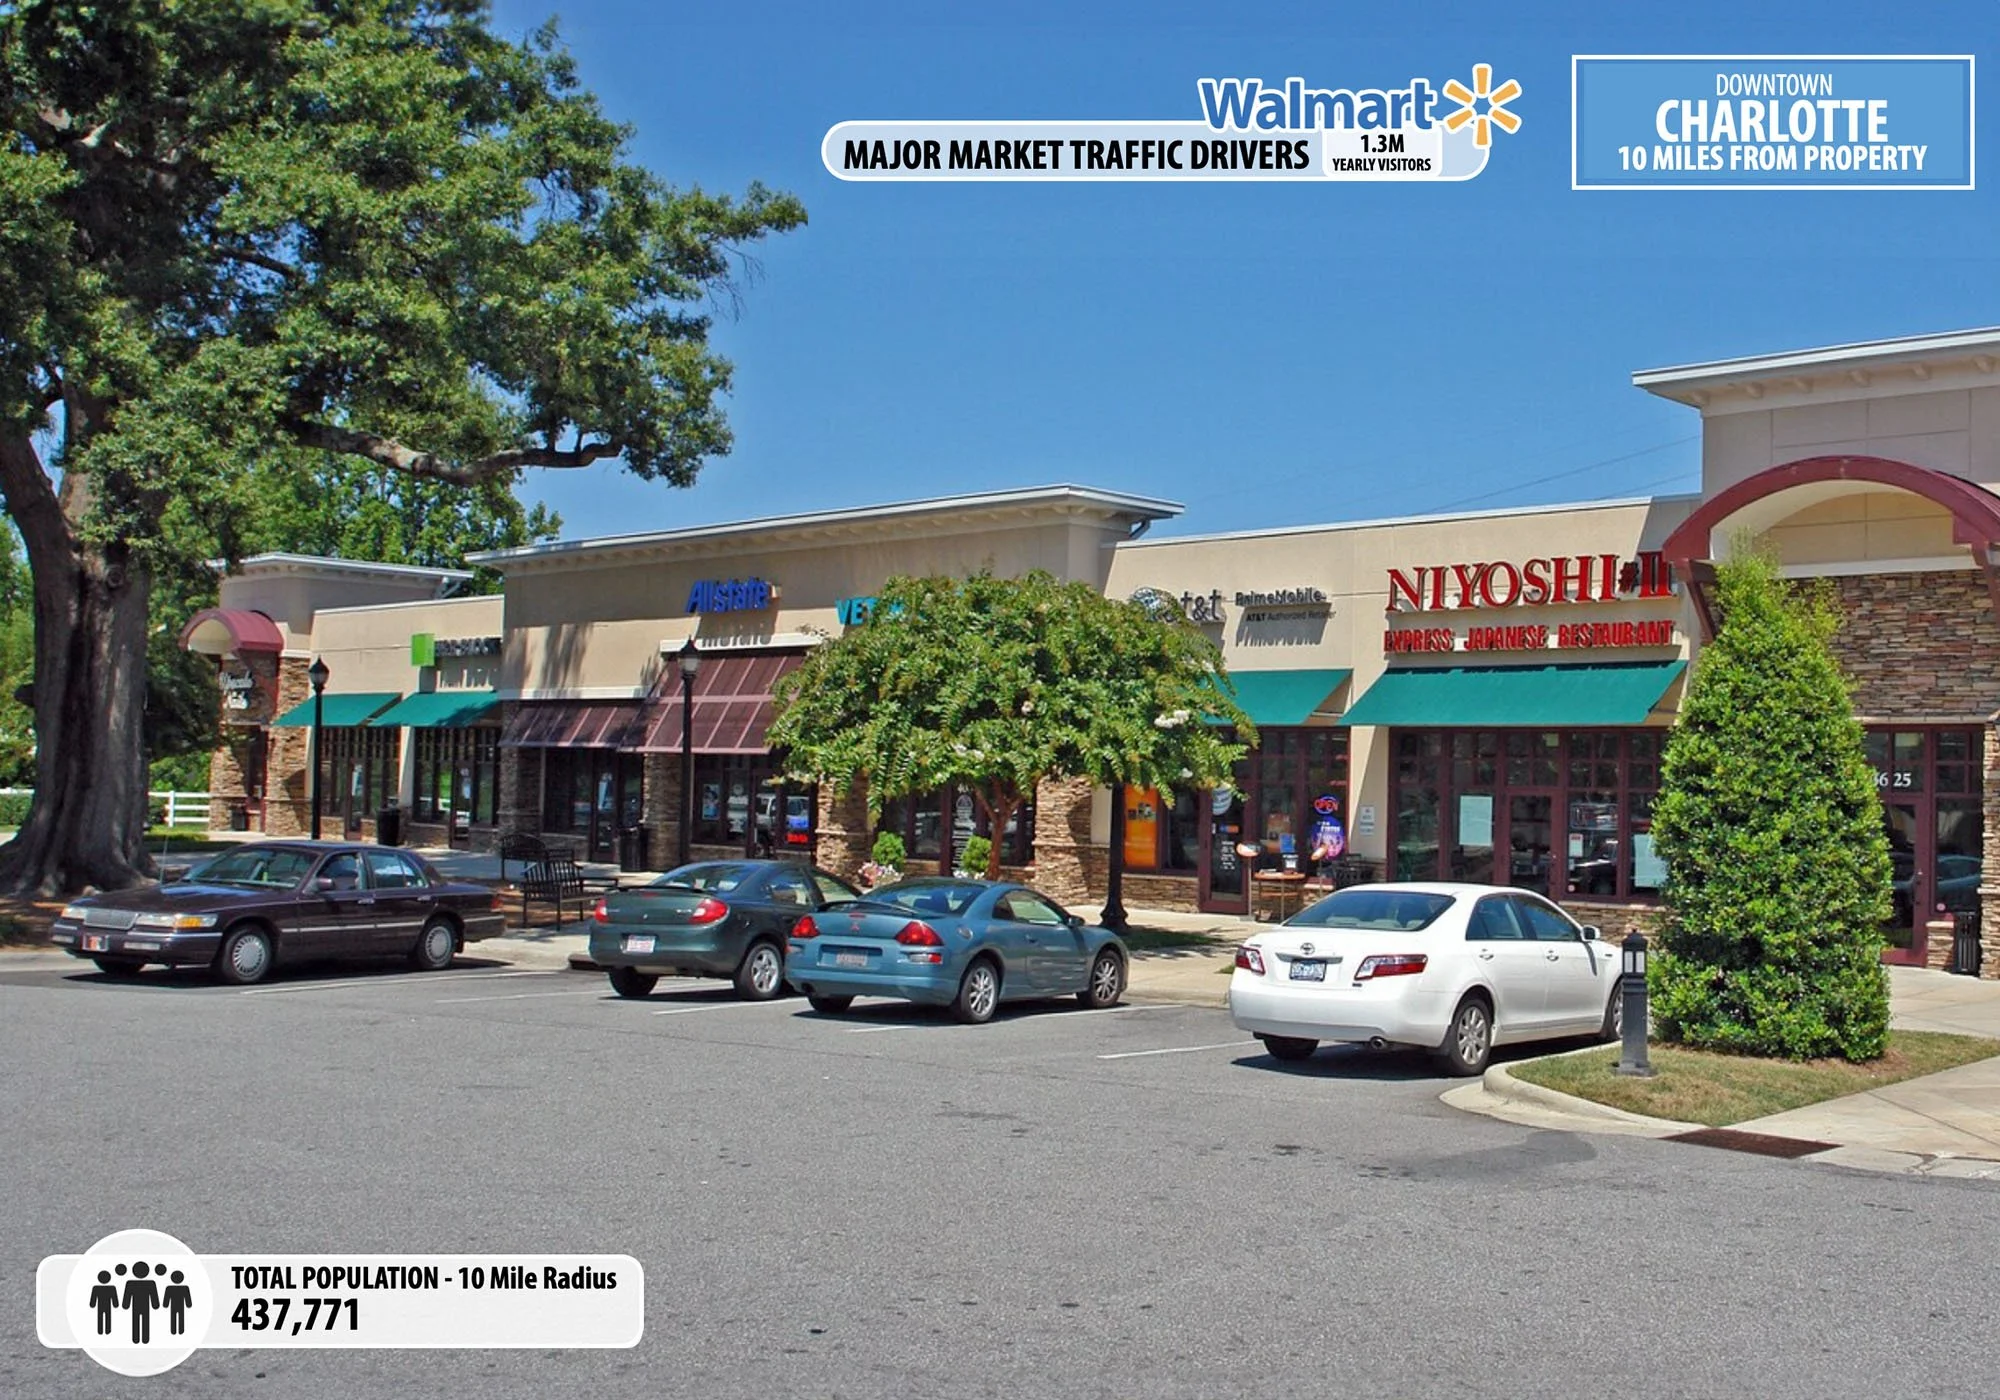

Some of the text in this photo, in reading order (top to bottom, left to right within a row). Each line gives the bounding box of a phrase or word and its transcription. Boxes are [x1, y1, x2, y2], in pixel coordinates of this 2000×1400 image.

[684, 577, 768, 613] Allstate
[1384, 620, 1675, 652] EXPRESS JAPANESE RESTAURANT
